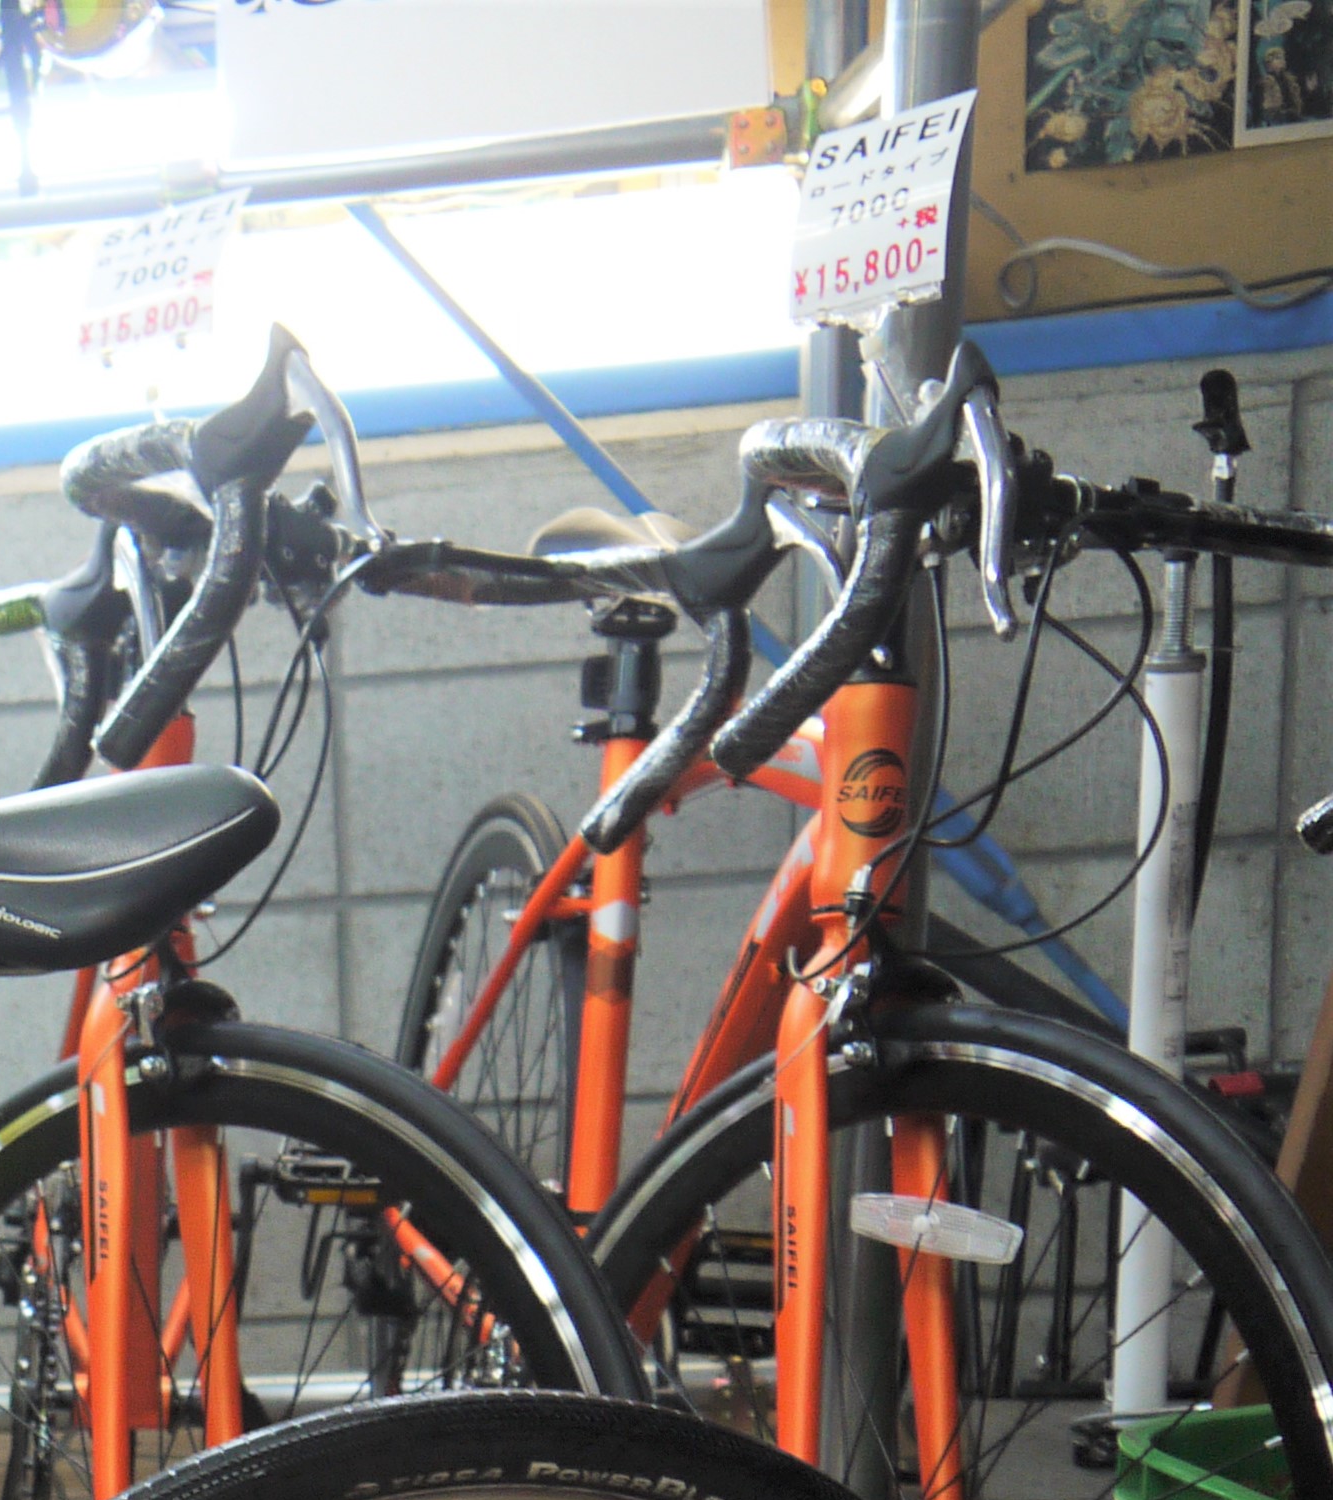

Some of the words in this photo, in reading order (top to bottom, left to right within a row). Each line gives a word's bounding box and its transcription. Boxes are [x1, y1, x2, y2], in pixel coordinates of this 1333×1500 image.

[816, 107, 961, 170] SAIFEI
[102, 199, 237, 247] SAIFEI
[836, 785, 907, 803] SAIFE
